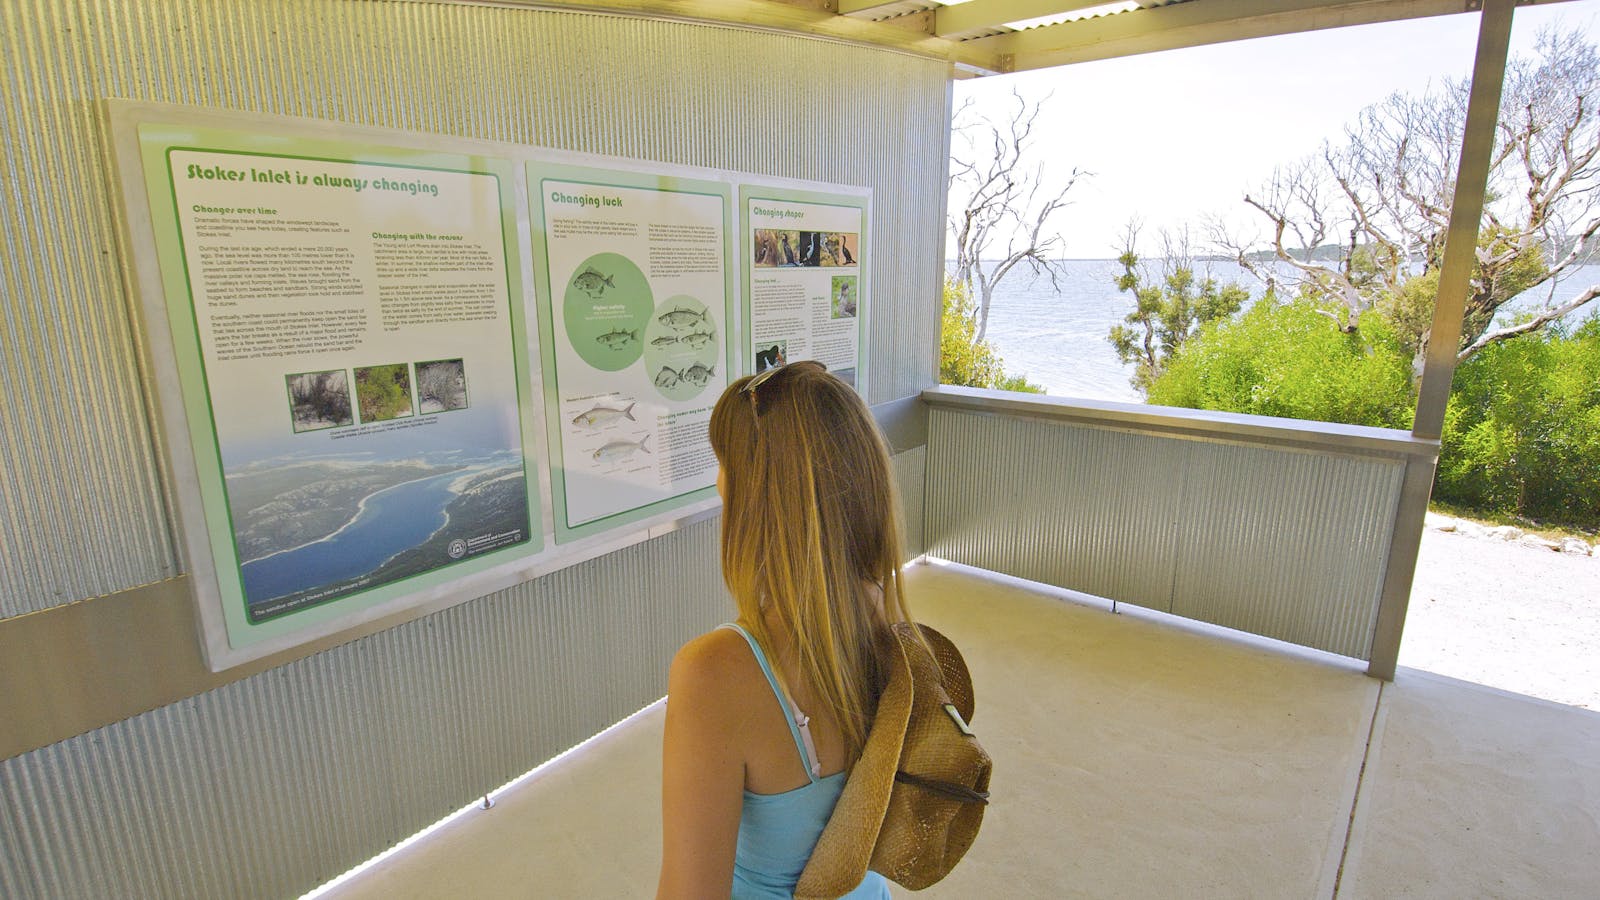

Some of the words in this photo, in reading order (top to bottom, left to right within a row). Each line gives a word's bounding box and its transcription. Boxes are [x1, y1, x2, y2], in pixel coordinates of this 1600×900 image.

[187, 164, 246, 181] Stokes
[251, 168, 291, 184] Inlet
[296, 170, 308, 186] is
[313, 171, 368, 192] always
[372, 178, 439, 196] changing
[551, 192, 600, 208] Changing
[603, 196, 622, 207] luck
[192, 204, 234, 215] Changes
[237, 207, 256, 215] over
[257, 206, 277, 215] time
[754, 206, 784, 219] Changing
[785, 208, 804, 218] shapes
[372, 232, 408, 240] Changing
